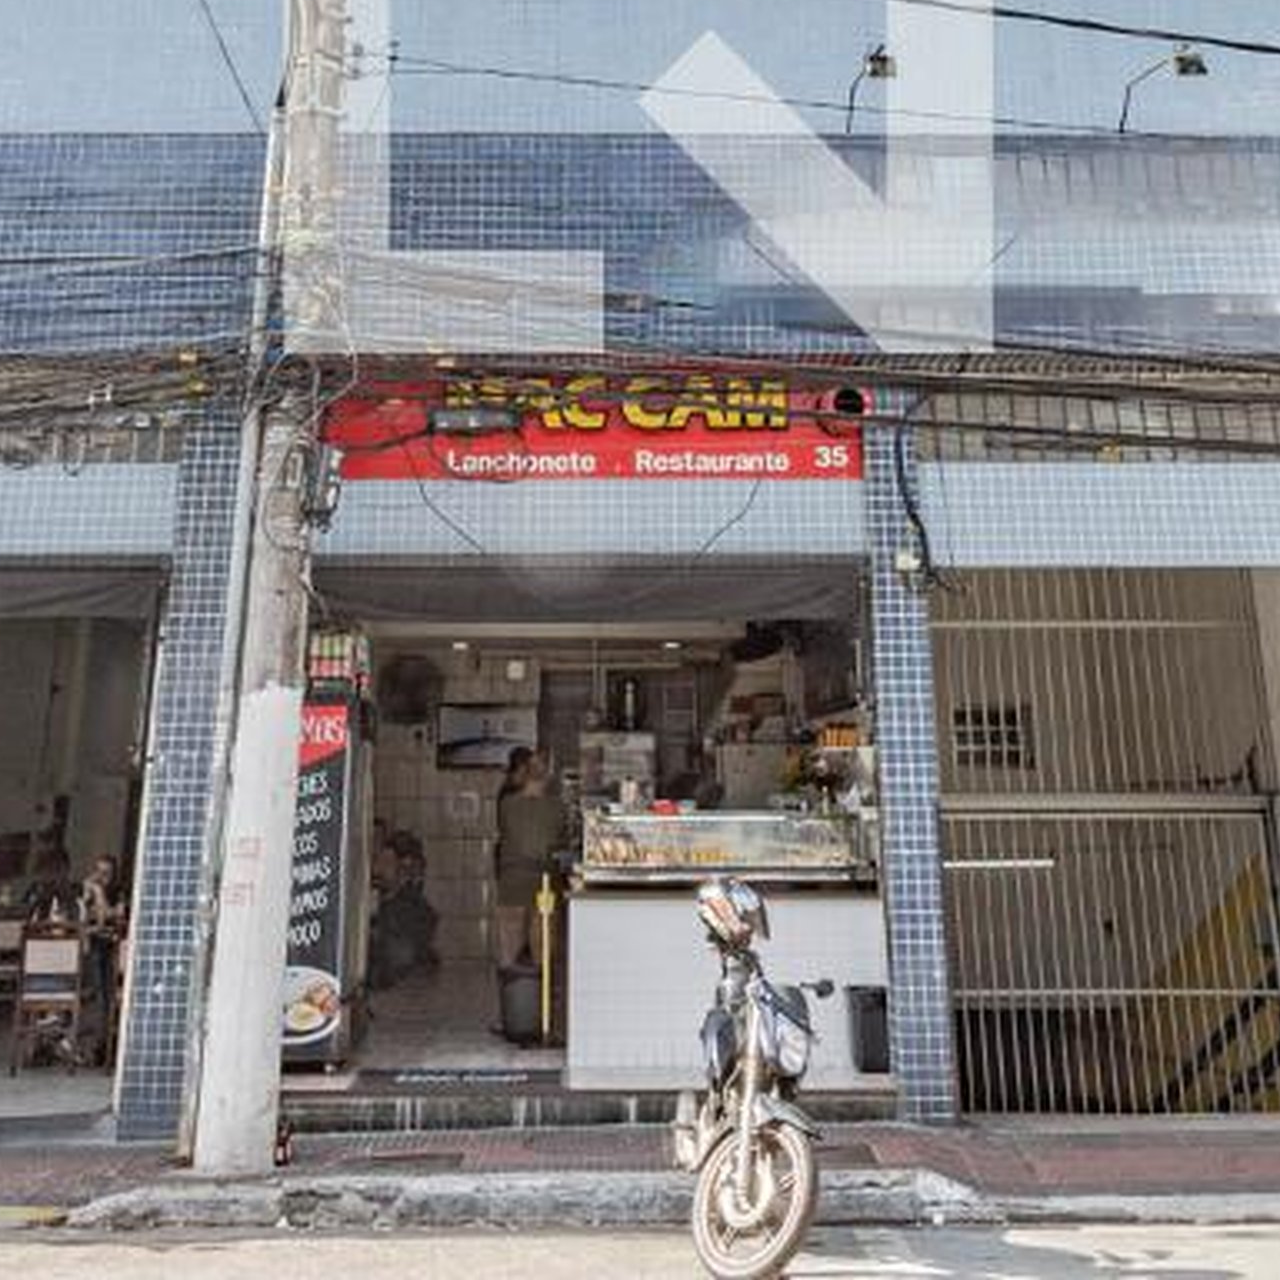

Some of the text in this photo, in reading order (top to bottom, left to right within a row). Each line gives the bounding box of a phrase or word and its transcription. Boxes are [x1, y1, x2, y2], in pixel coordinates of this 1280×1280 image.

[446, 445, 849, 473] Lanchonete Restaurante 35
